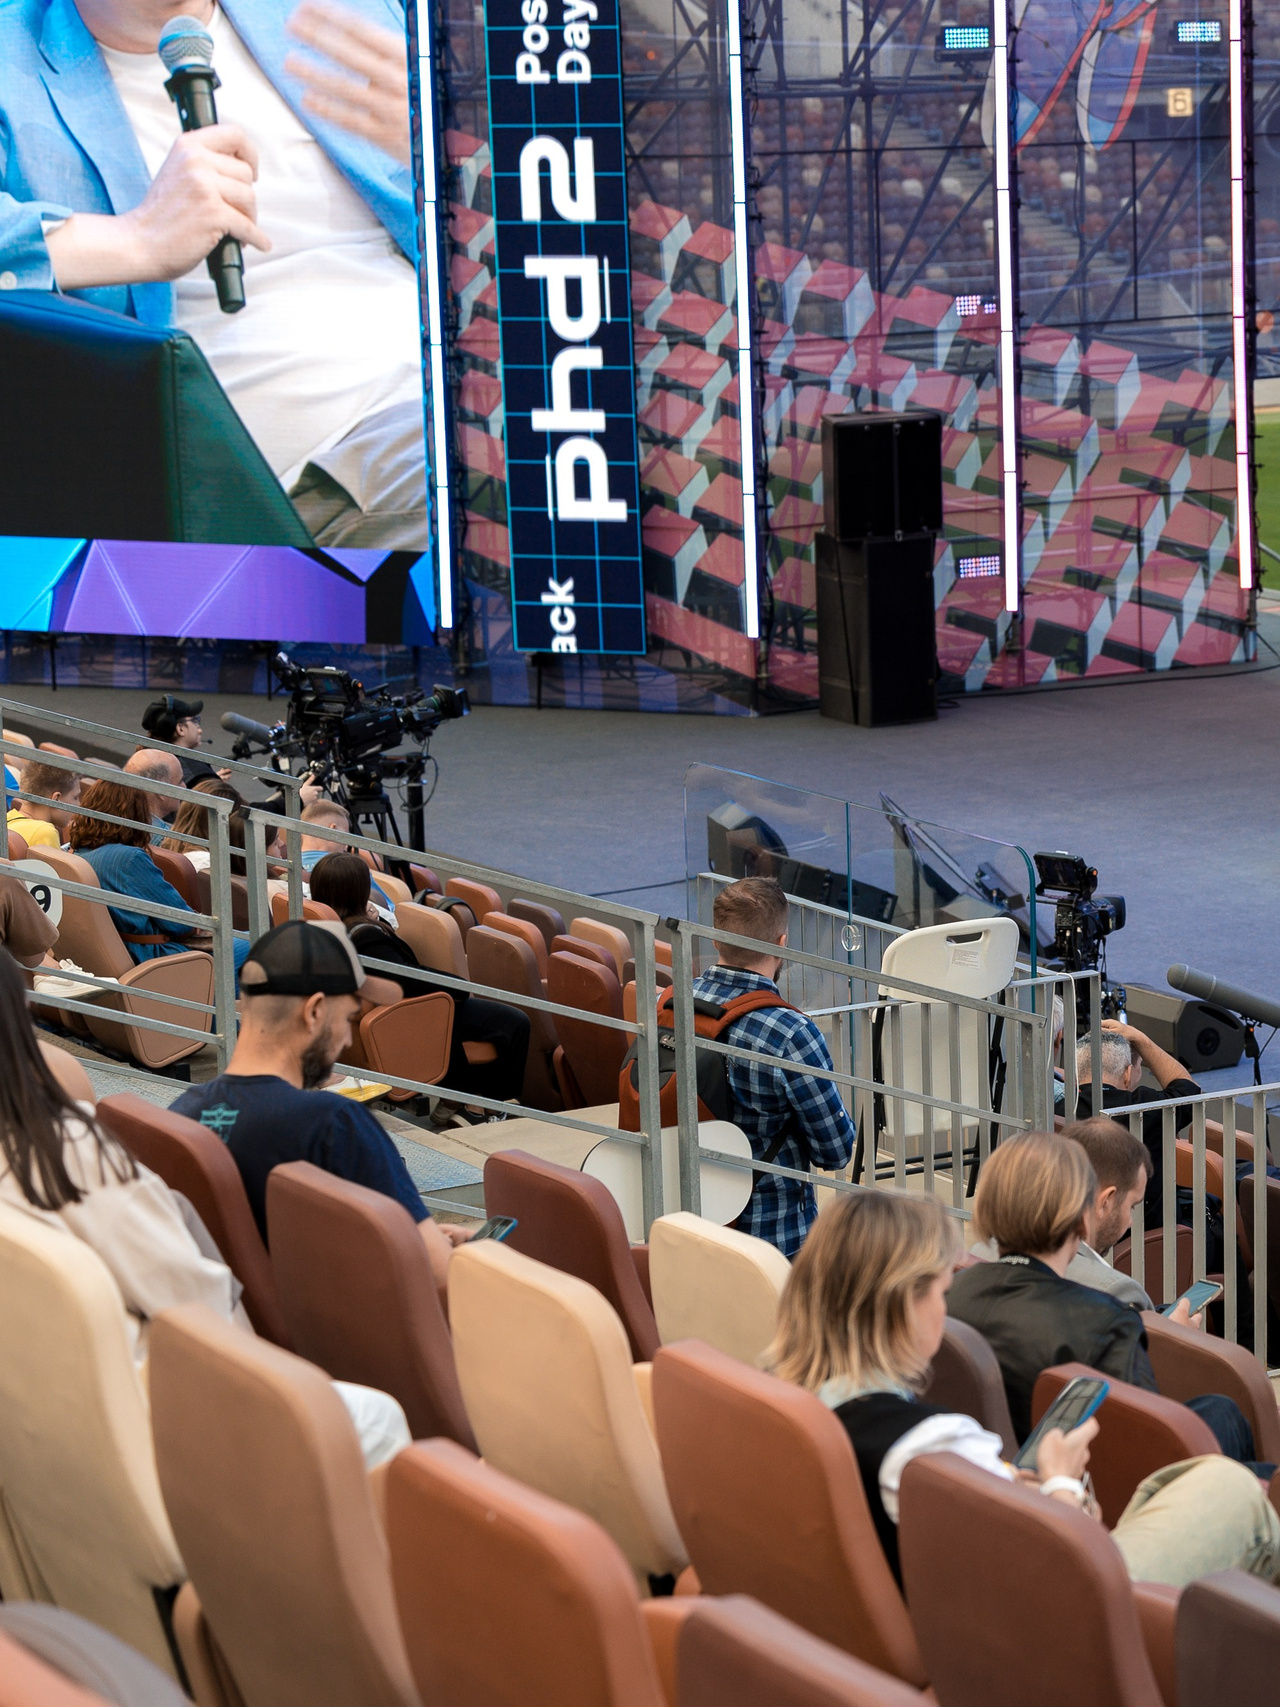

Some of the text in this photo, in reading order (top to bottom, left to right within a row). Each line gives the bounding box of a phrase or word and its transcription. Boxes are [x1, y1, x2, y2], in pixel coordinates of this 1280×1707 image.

[1173, 92, 1187, 112] 6
[519, 134, 628, 522] phd 2
